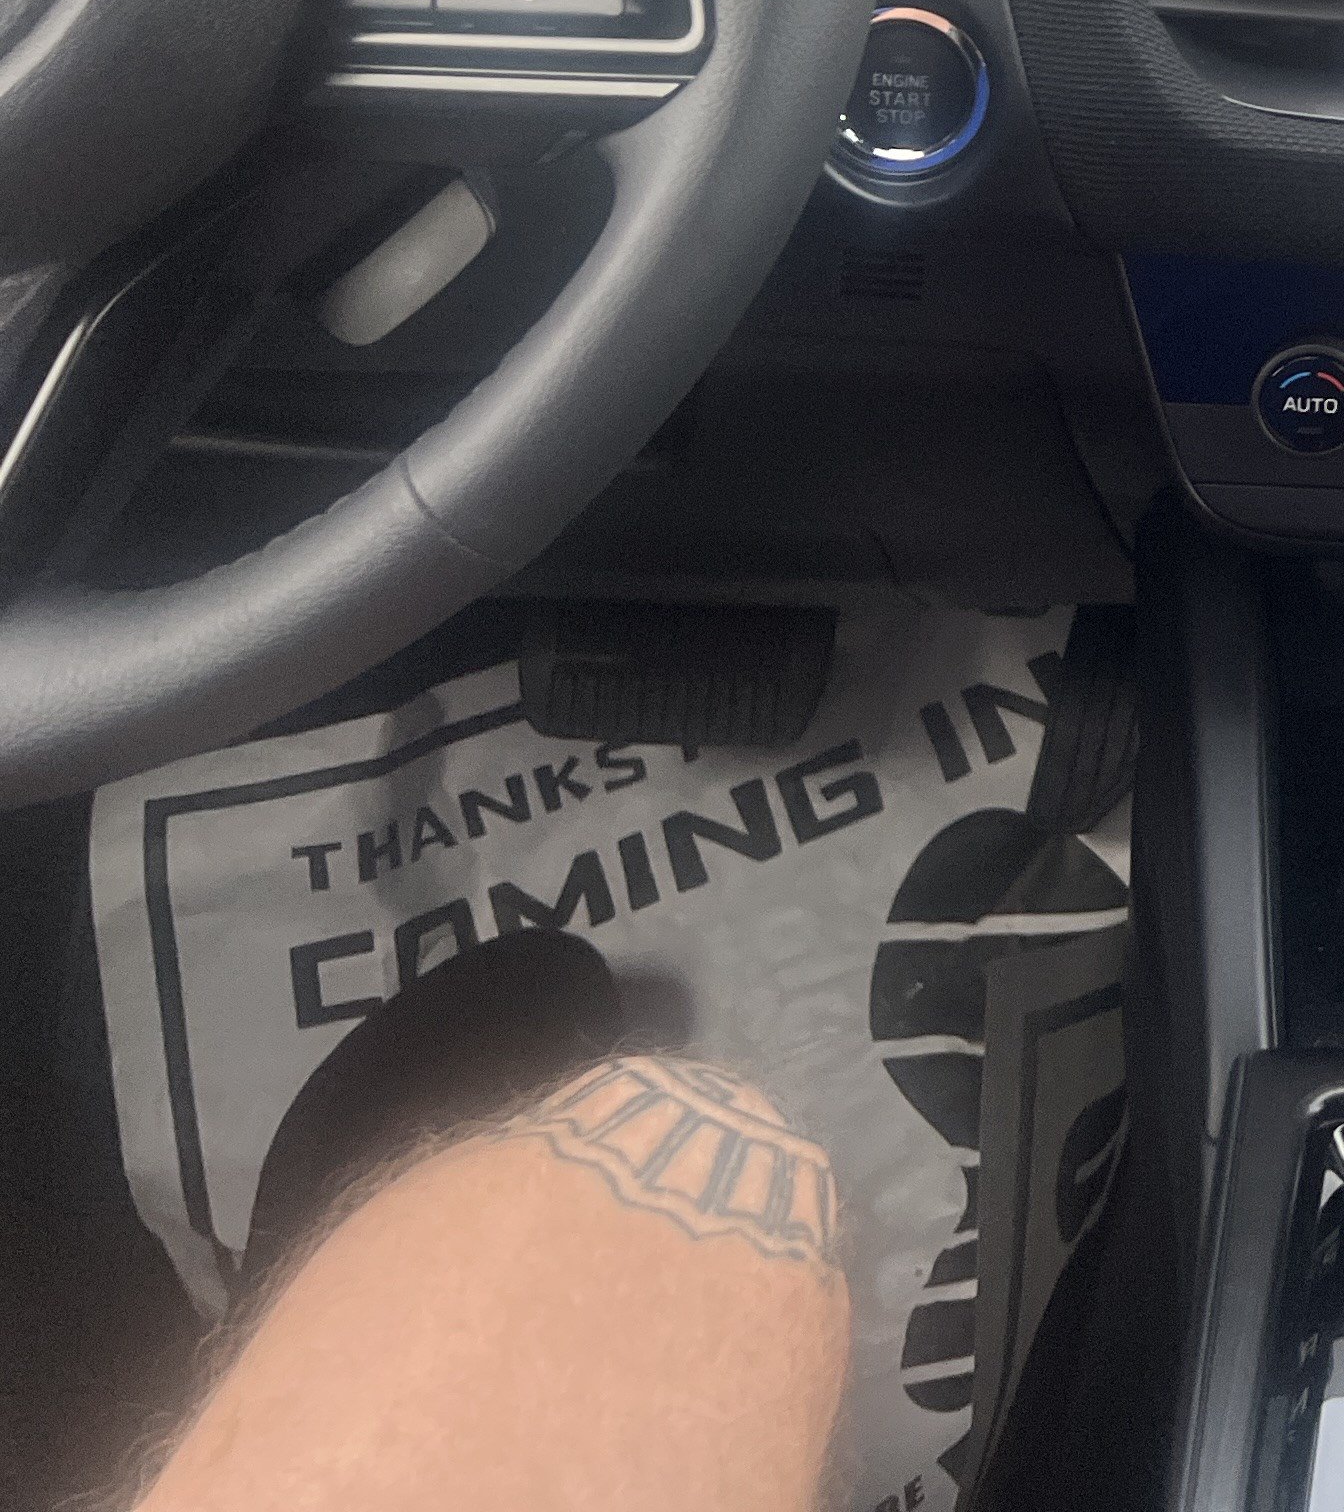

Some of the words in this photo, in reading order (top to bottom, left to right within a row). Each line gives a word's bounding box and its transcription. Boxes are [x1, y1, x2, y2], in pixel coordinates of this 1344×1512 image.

[872, 72, 930, 89] ENGINE
[869, 90, 931, 106] START
[876, 108, 926, 125] STOP
[1282, 397, 1339, 414] AUTO
[290, 742, 648, 891] THANKS
